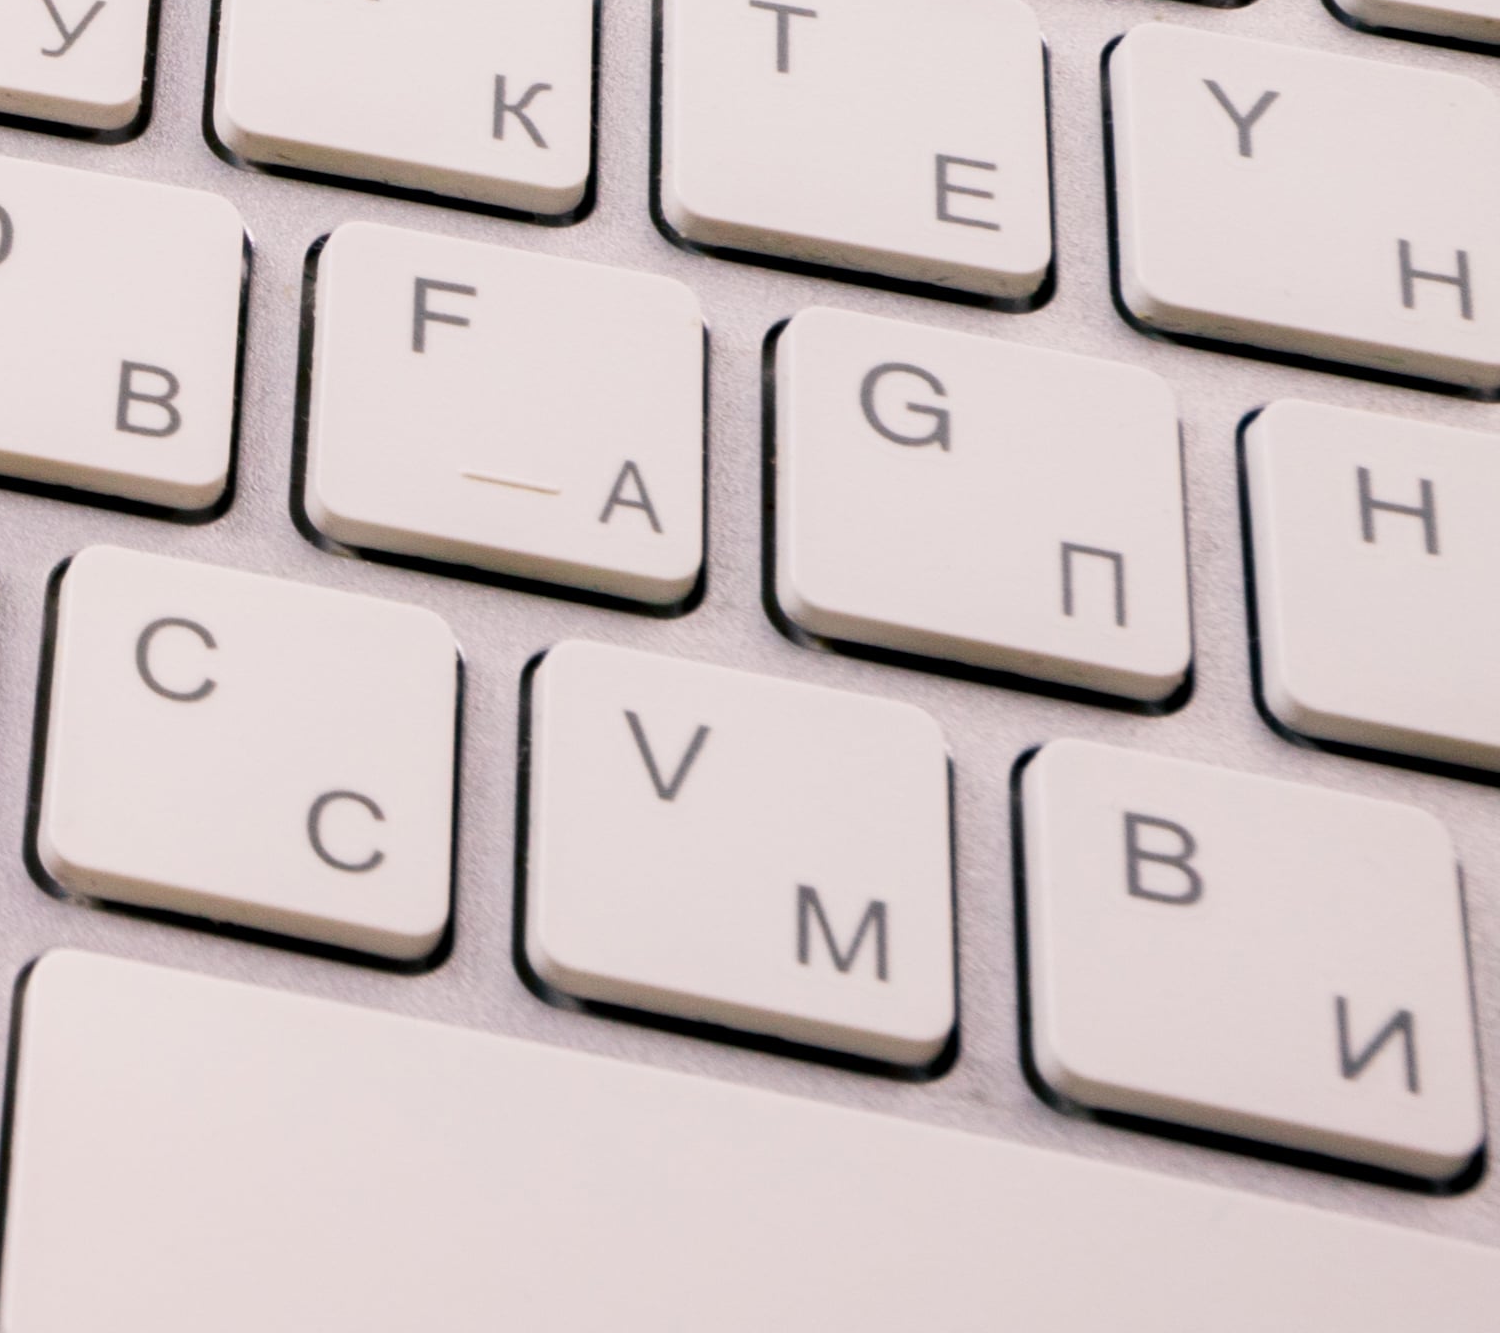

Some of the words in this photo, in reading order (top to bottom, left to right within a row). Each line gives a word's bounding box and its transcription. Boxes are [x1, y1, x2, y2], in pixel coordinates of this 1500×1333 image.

[748, 0, 818, 74] T
[1203, 79, 1280, 159] Y
[411, 276, 477, 354] F
[858, 361, 951, 452] G
[1356, 466, 1440, 556] H
[134, 616, 218, 704] C
[624, 710, 711, 802] V
[1122, 811, 1204, 907] B
